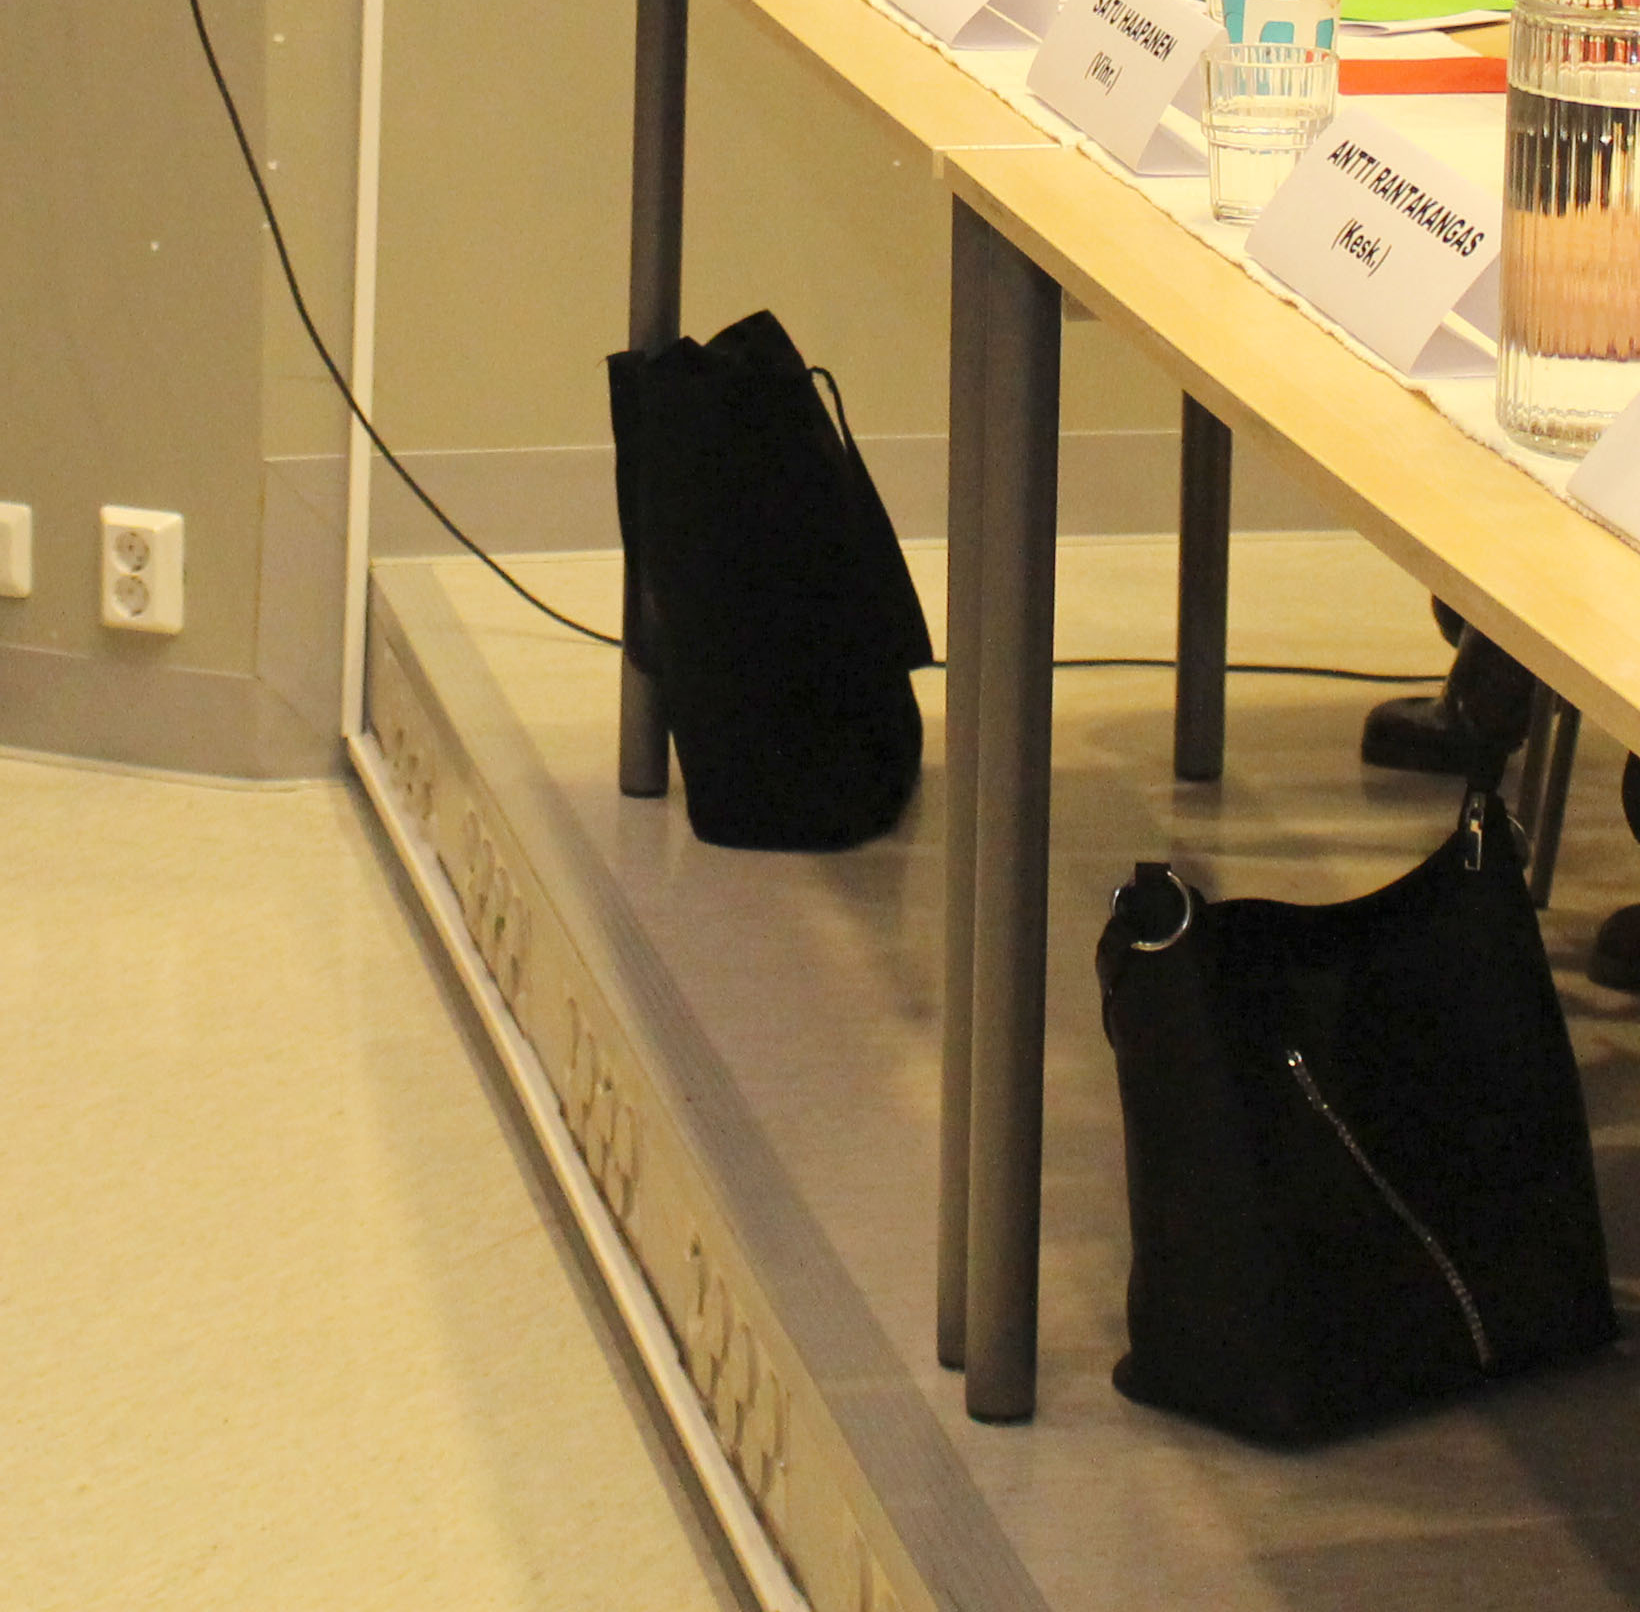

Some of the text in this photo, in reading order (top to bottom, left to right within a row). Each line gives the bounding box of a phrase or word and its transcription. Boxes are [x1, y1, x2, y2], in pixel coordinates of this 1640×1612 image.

[1117, 8, 1178, 62] HAAPANEN
[1084, 50, 1123, 96] (Vihr.)
[1327, 140, 1485, 257] ANTTI RANTAKANGAS
[1331, 218, 1392, 277] (Kesk.)
